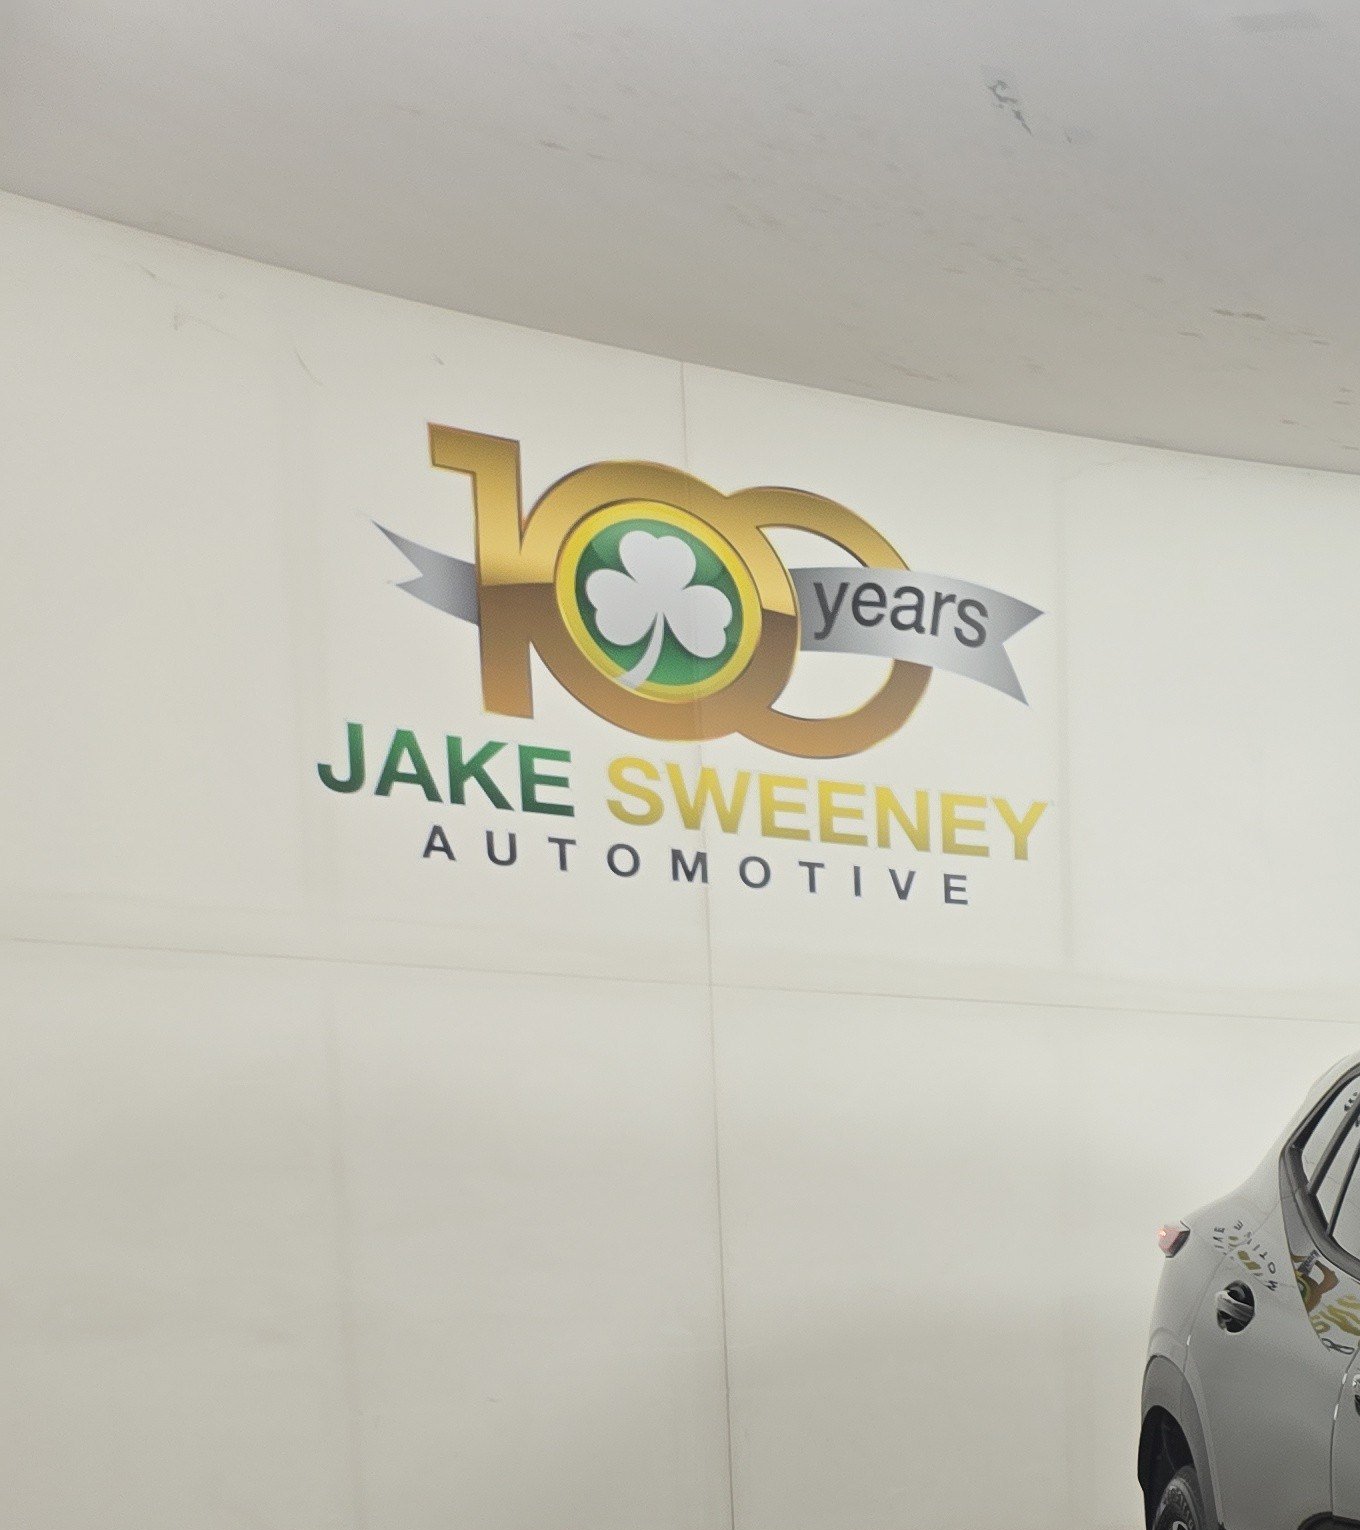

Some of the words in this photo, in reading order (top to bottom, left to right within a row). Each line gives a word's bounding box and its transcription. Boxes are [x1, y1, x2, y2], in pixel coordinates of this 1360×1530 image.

[426, 421, 934, 760] 100
[812, 580, 990, 649] years
[317, 721, 576, 819] JAKE
[606, 756, 1049, 863] SWEENEY
[422, 824, 970, 906] AUTOMOTIVE
